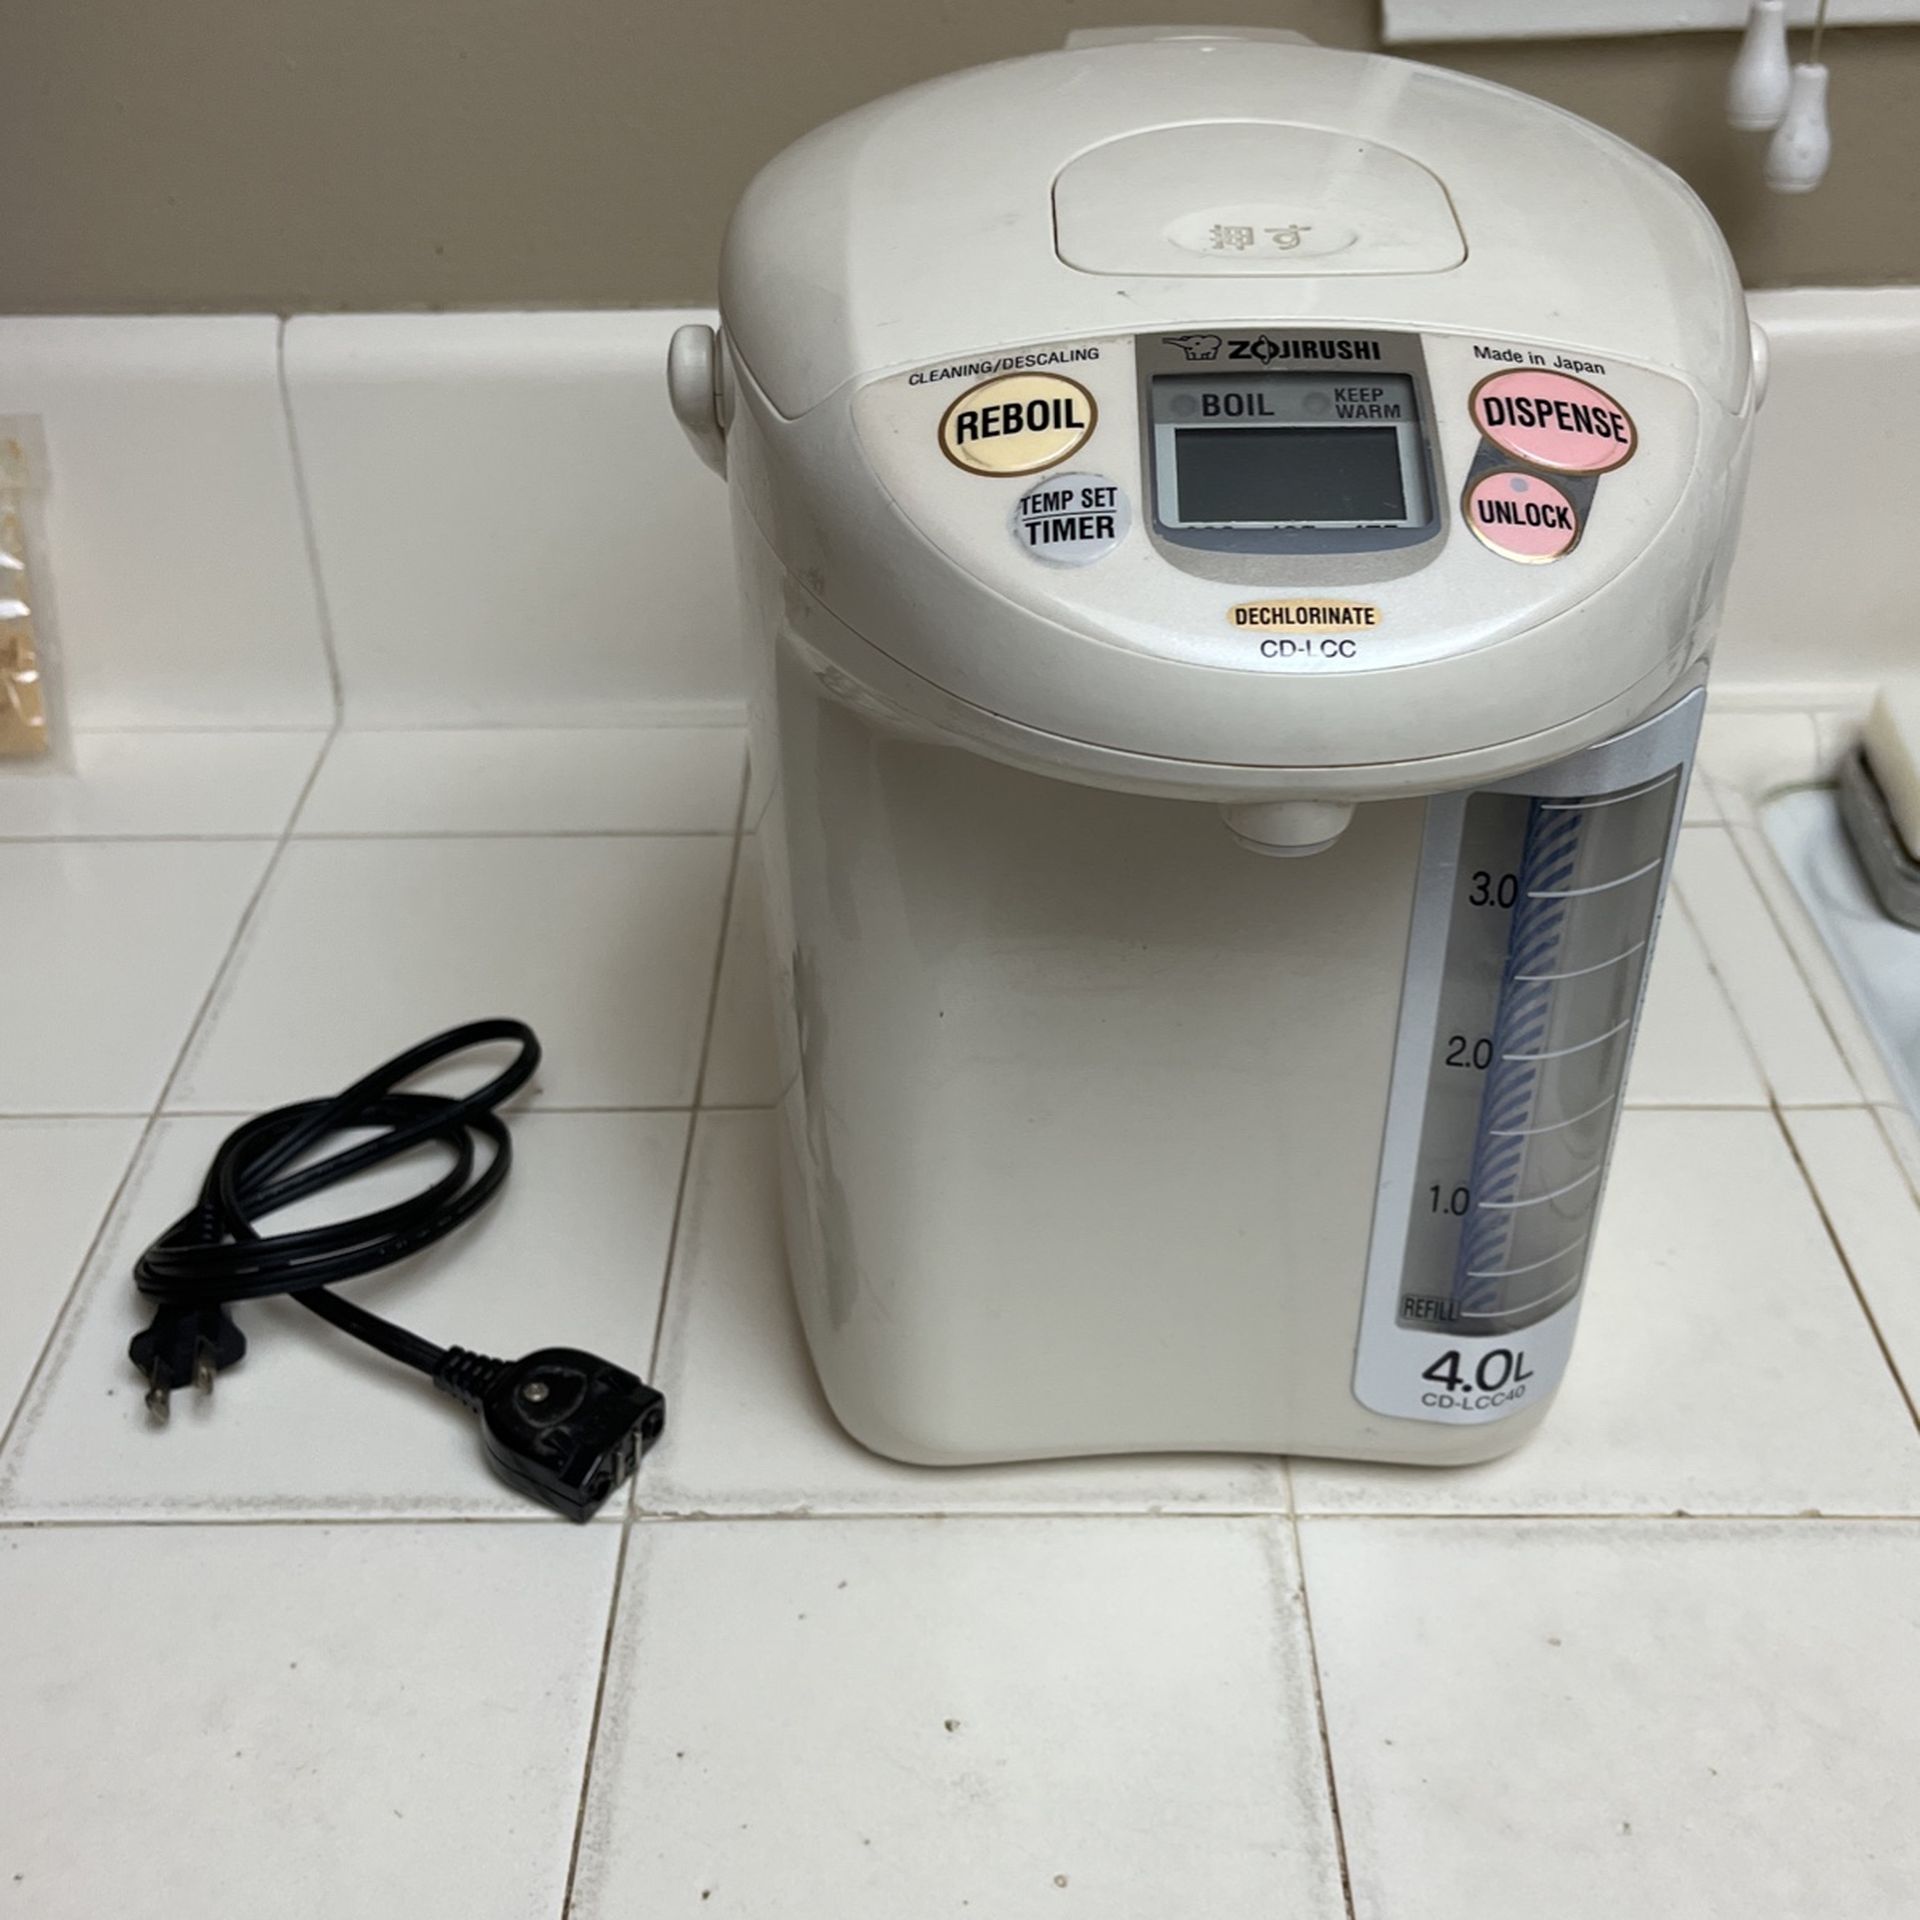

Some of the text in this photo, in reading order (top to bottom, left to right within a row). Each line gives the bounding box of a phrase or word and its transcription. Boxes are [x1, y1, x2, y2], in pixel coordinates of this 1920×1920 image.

[1227, 335, 1381, 366] ZOJIRUSHI
[1473, 345, 1606, 375] Made in Japan
[908, 347, 1100, 386] CLEANING/DESCALING
[1202, 392, 1275, 417] BOIL
[1334, 387, 1384, 403] KEEP
[956, 398, 1085, 446] REBOIL
[1335, 403, 1401, 420] WARM
[1482, 396, 1629, 445] DISPENSE
[1020, 486, 1118, 516] TEMP SET
[1477, 498, 1574, 532] UNLOCK
[1025, 515, 1116, 546] TIMER
[1234, 605, 1376, 627] DECHLORINATE
[1259, 639, 1357, 660] CD-LCC
[1469, 871, 1519, 909] 3.0
[1445, 1036, 1494, 1070] 2.0
[1428, 1184, 1471, 1216] 1.0
[1403, 1297, 1459, 1322] REFILL
[1420, 1384, 1526, 1412] CD-LCC40
